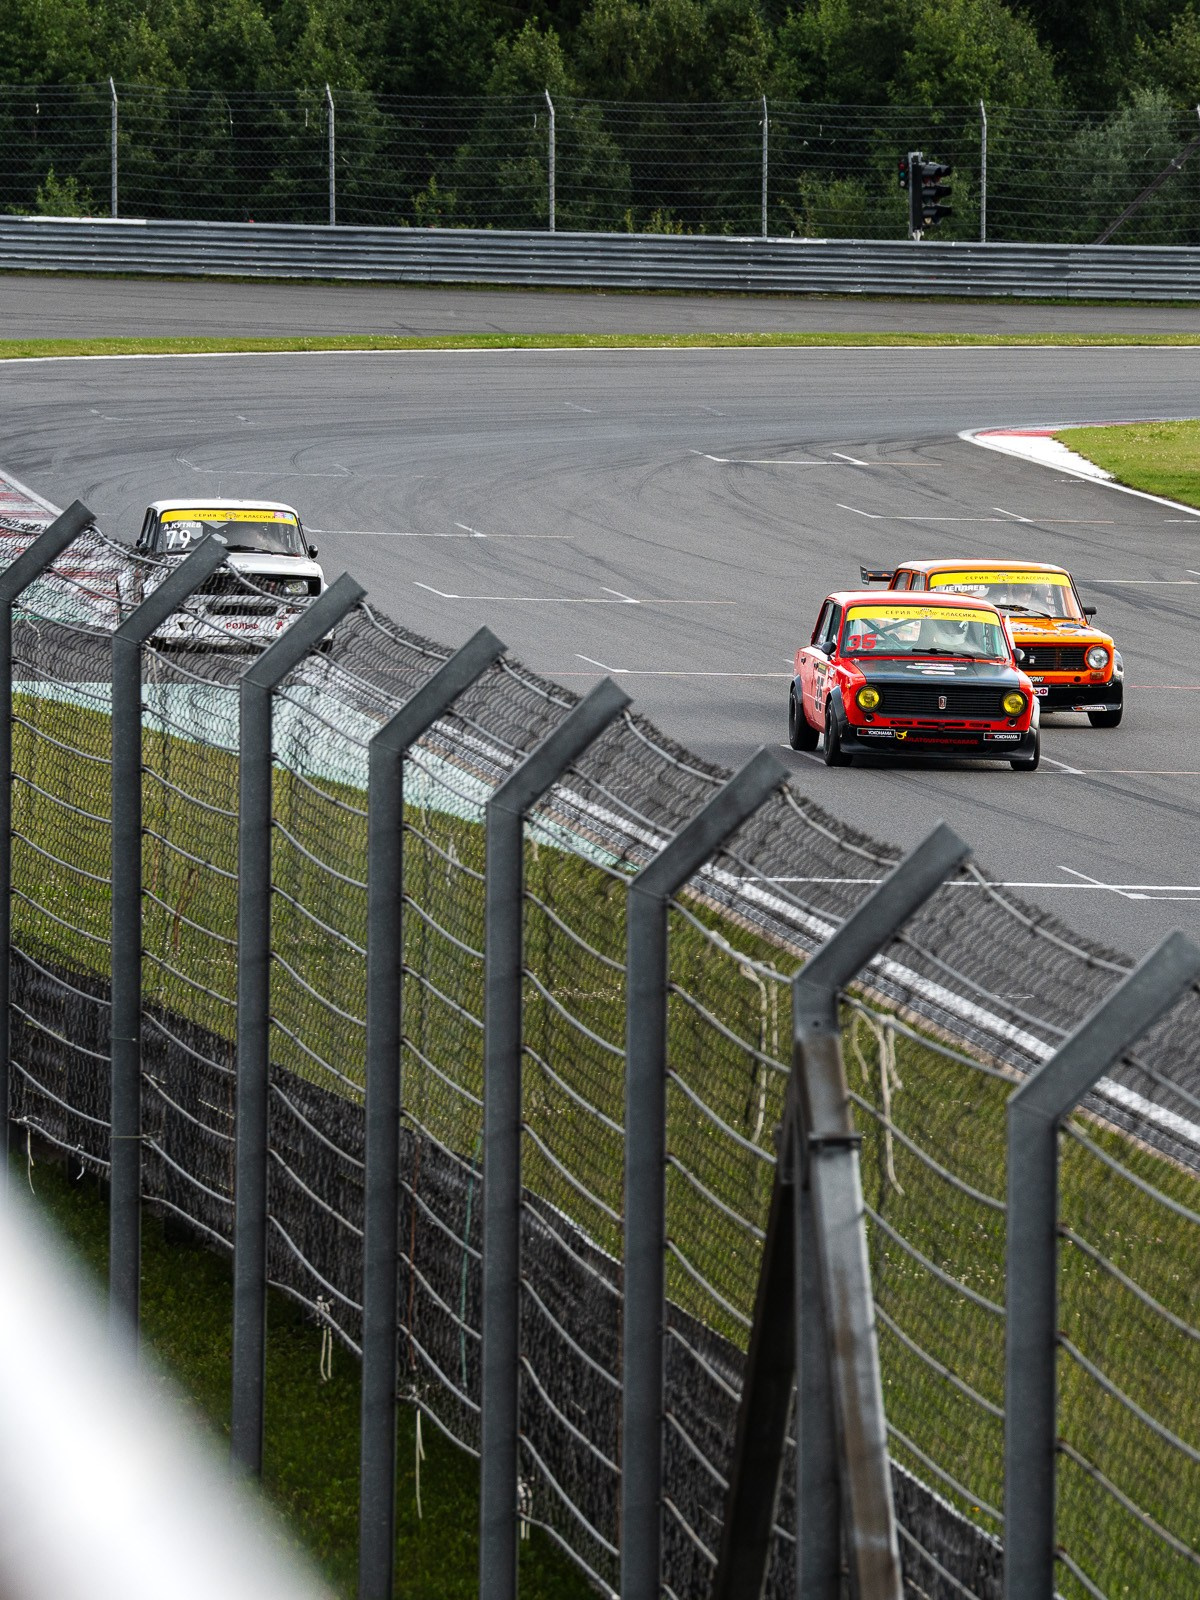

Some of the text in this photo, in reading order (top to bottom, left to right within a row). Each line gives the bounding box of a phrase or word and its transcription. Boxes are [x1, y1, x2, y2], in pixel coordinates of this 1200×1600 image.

[163, 521, 202, 530] А.КУТЯЕВ
[166, 530, 191, 549] 79
[846, 633, 877, 652] 35
